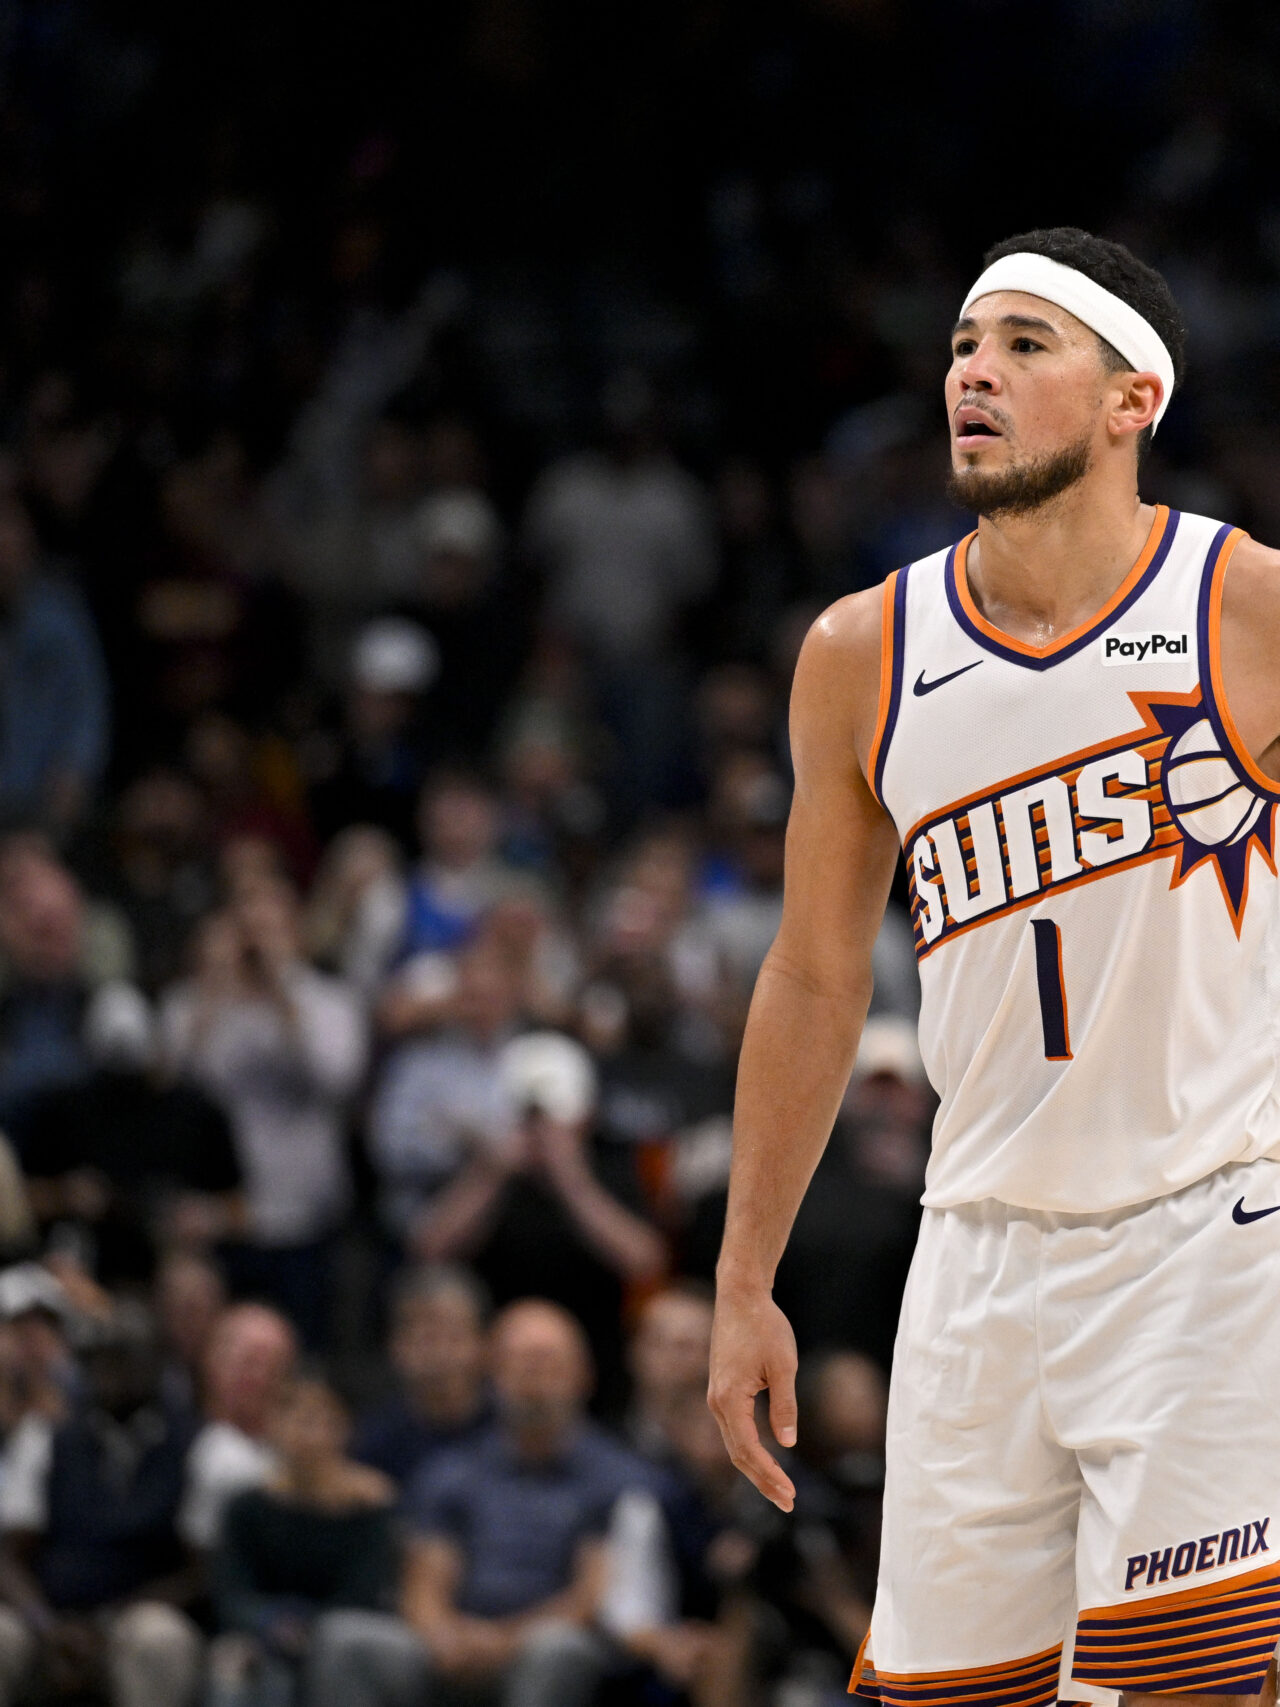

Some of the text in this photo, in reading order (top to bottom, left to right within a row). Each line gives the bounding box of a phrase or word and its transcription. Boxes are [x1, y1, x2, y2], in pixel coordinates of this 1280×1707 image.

[1105, 634, 1188, 661] PayPal
[1030, 918, 1073, 1061] 1
[1124, 1516, 1271, 1592] PHOENIX
